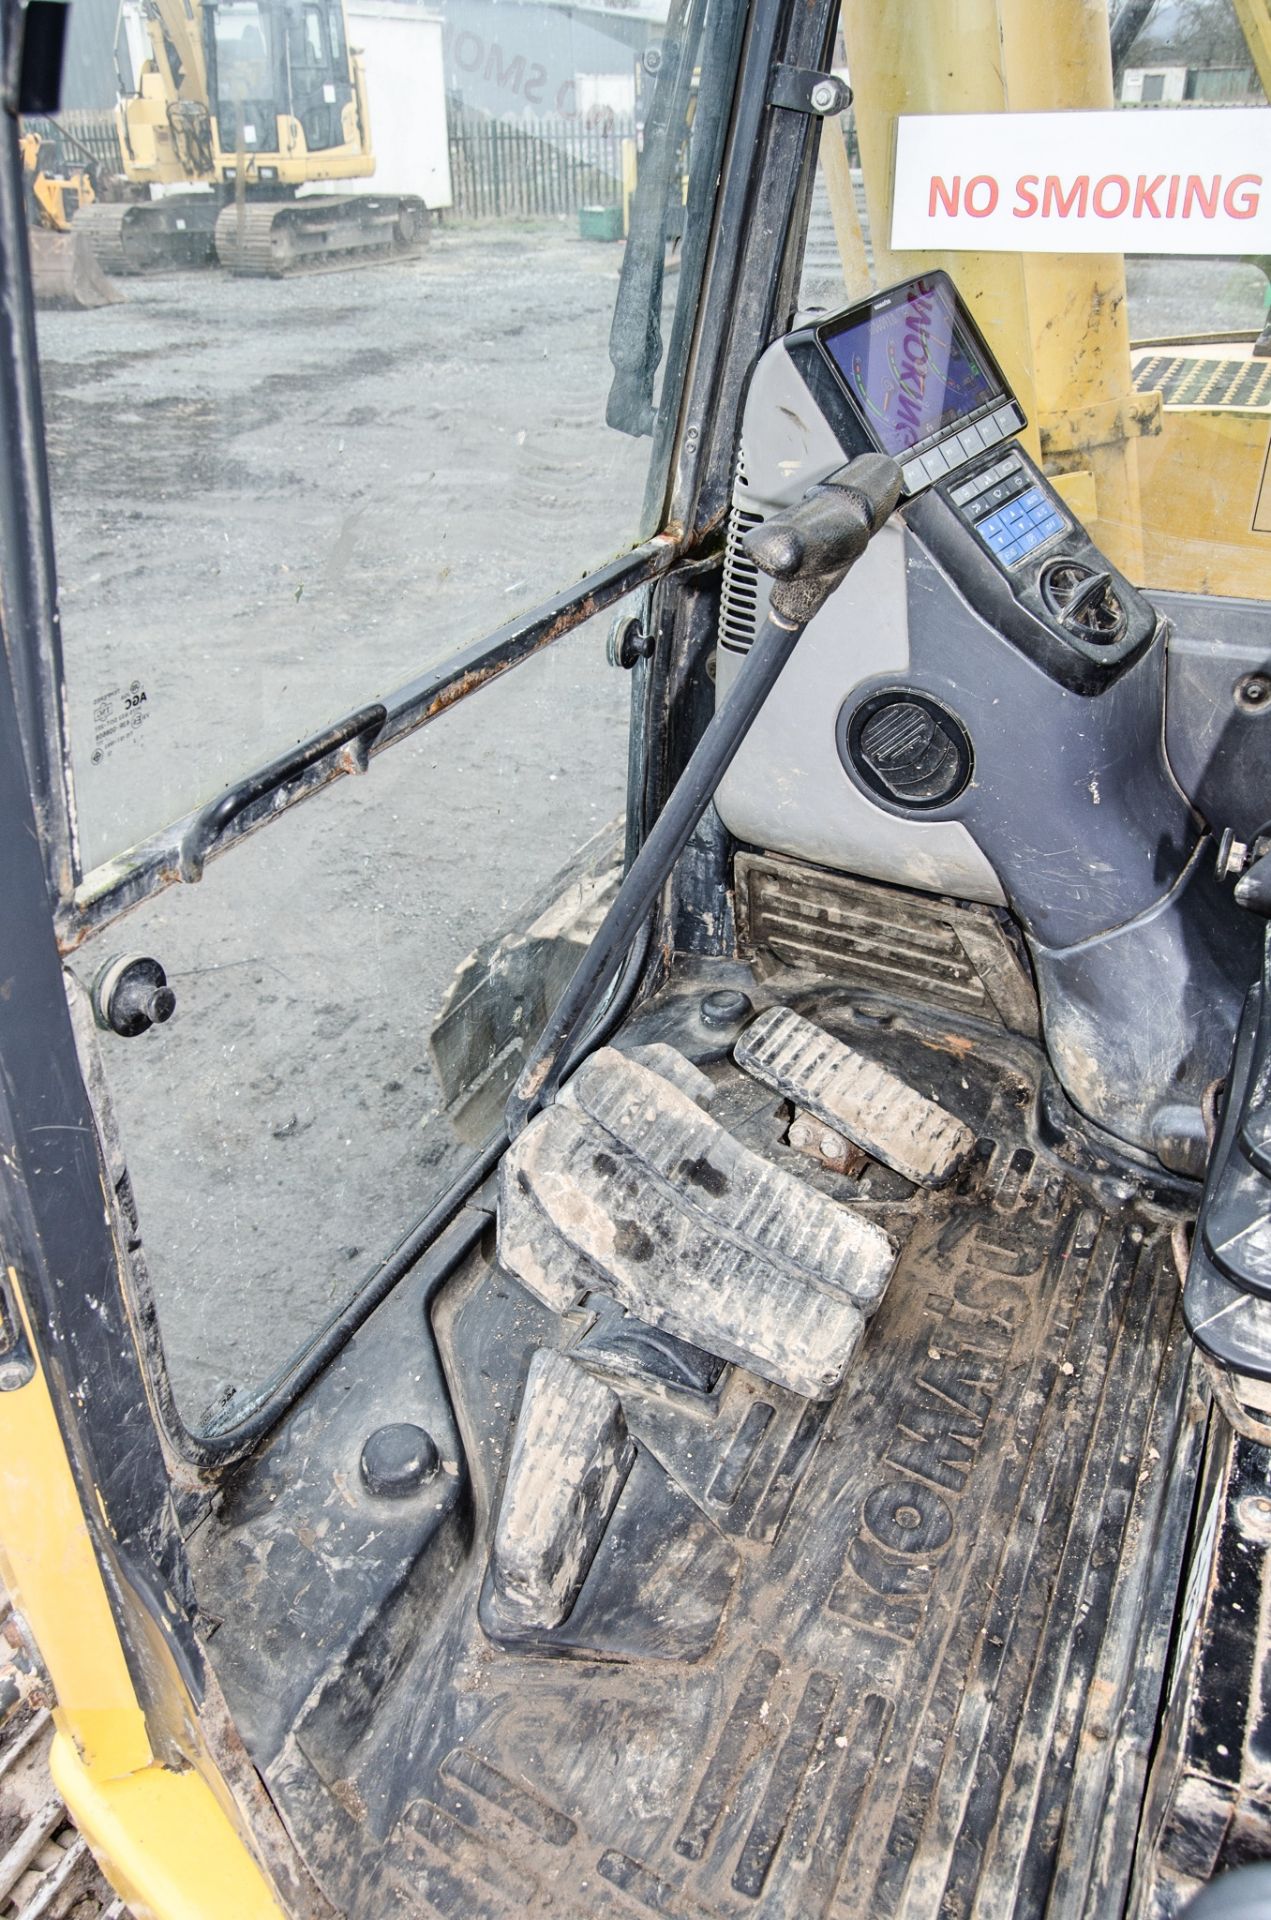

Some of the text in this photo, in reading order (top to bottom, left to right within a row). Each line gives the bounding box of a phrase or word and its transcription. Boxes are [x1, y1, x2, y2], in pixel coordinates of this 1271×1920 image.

[928, 173, 1263, 220] NO SMOKING
[825, 1222, 1049, 1645] KOMATSU
